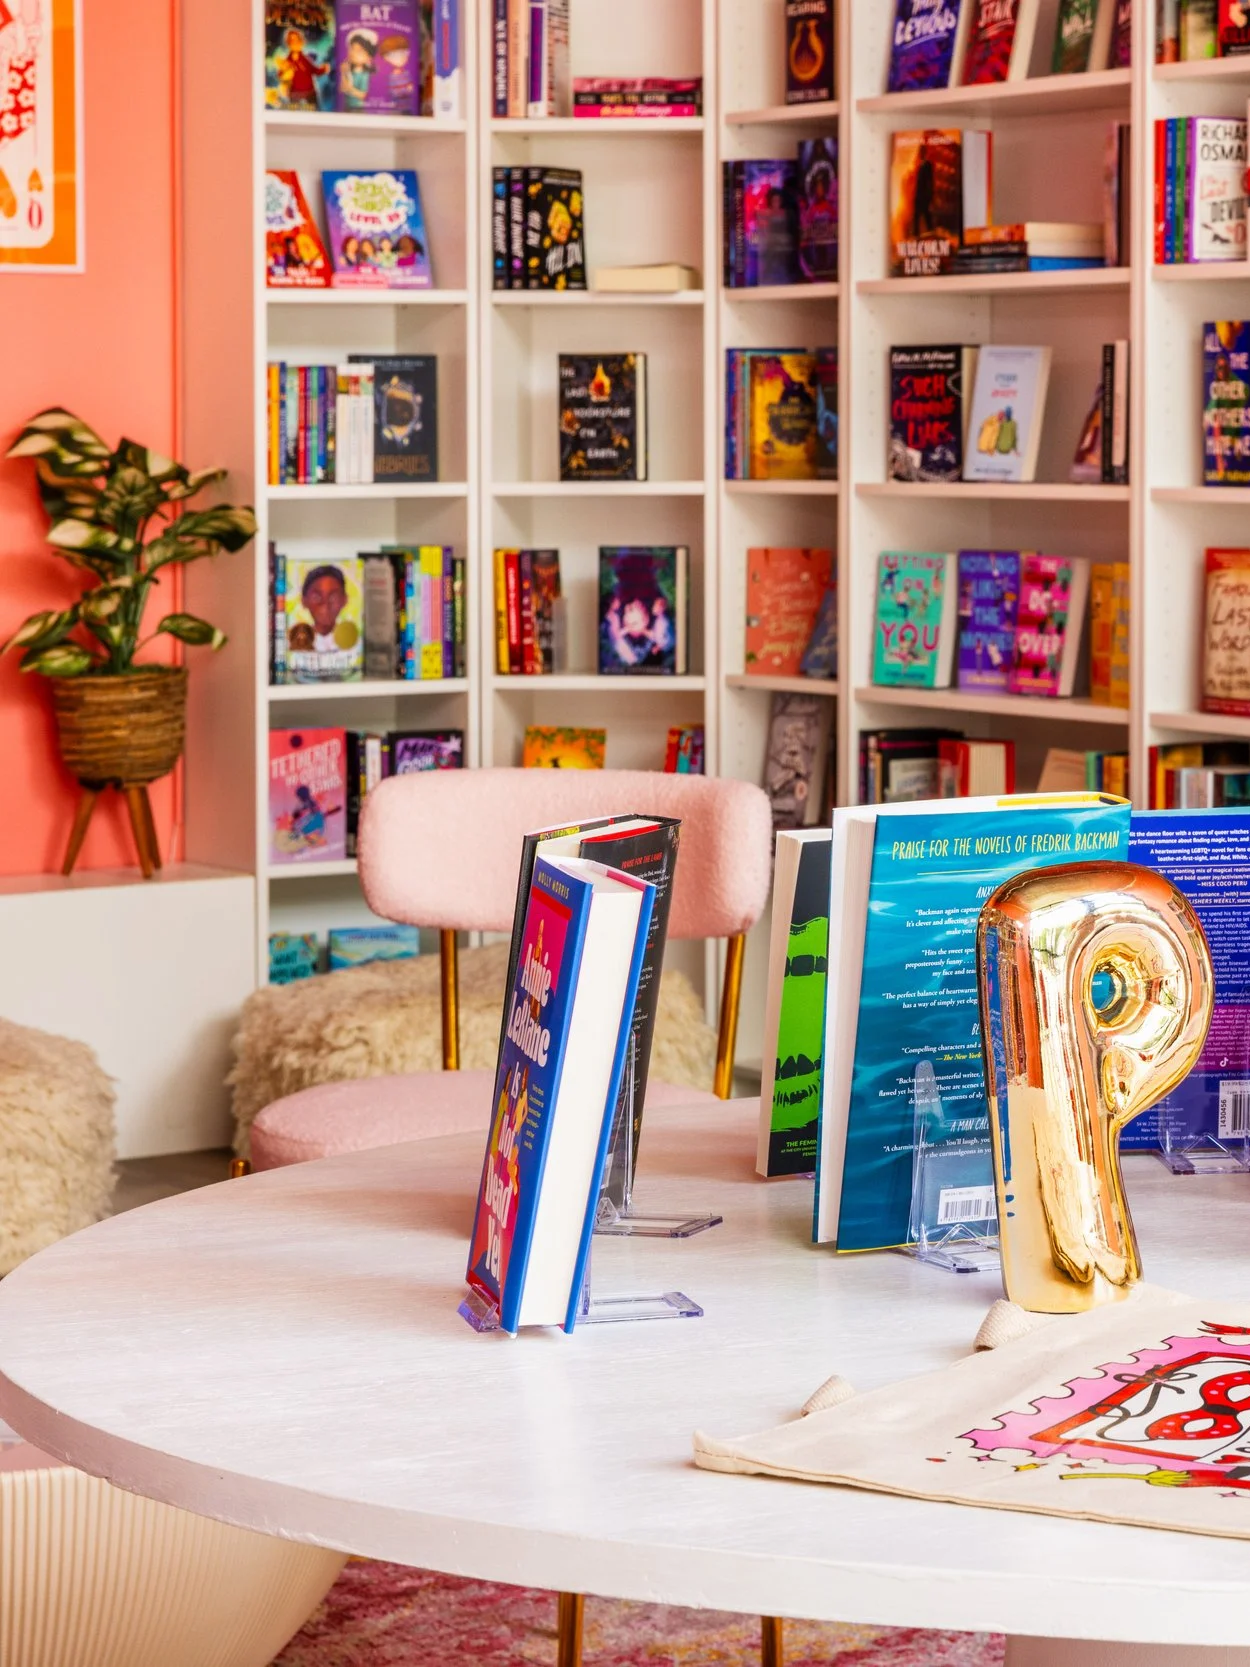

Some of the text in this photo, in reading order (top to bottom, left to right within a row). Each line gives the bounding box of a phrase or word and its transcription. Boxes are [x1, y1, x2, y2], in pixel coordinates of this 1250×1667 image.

[360, 5, 394, 21] BAT
[1200, 143, 1248, 161] OSMA
[1229, 352, 1249, 370] THE
[899, 374, 946, 400] SUCH
[1210, 380, 1246, 400] OTHER
[880, 621, 942, 651] YOU
[892, 831, 1120, 860] PRAISE FOR THE NOVELS OF FREDRIK BACKMAN
[521, 942, 552, 1007] Annie
[905, 958, 963, 970] preposterously funny
[896, 991, 916, 1000] perfect
[917, 990, 938, 998] balance
[505, 991, 551, 1068] LeBlanc
[511, 1061, 522, 1100] Is
[936, 1073, 961, 1081] masterful
[485, 1153, 514, 1229] Dead
